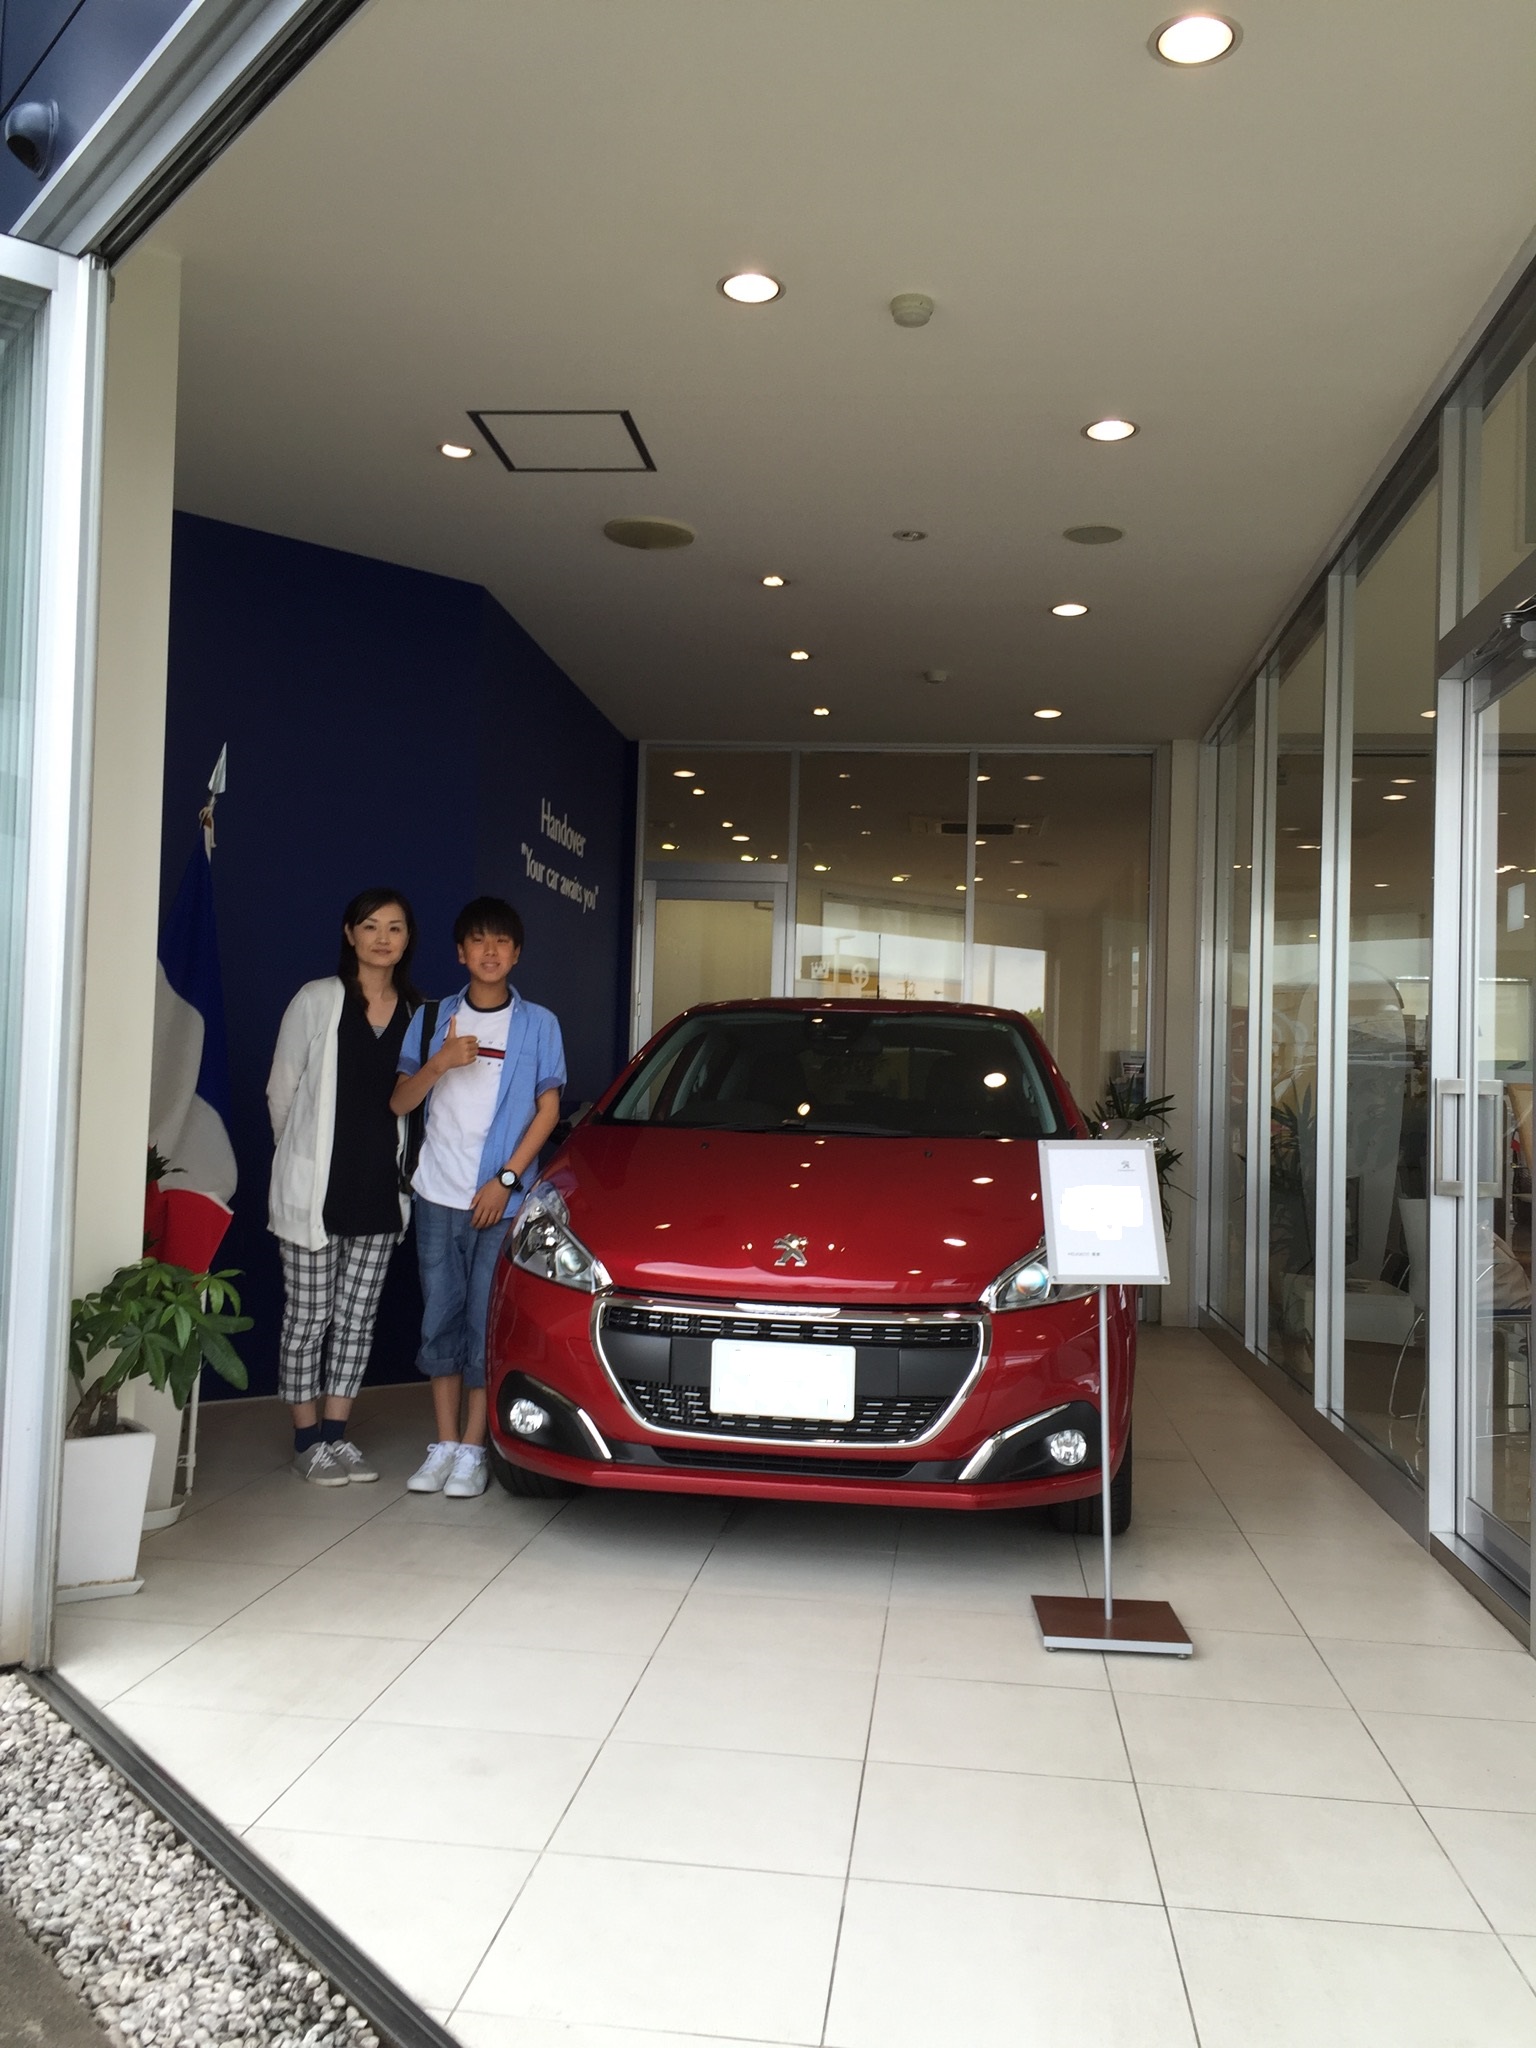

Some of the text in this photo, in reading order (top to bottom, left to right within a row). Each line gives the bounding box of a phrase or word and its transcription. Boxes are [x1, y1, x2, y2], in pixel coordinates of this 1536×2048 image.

[541, 797, 586, 859] Handover
[546, 868, 560, 891] car
[560, 876, 583, 903] awaits
